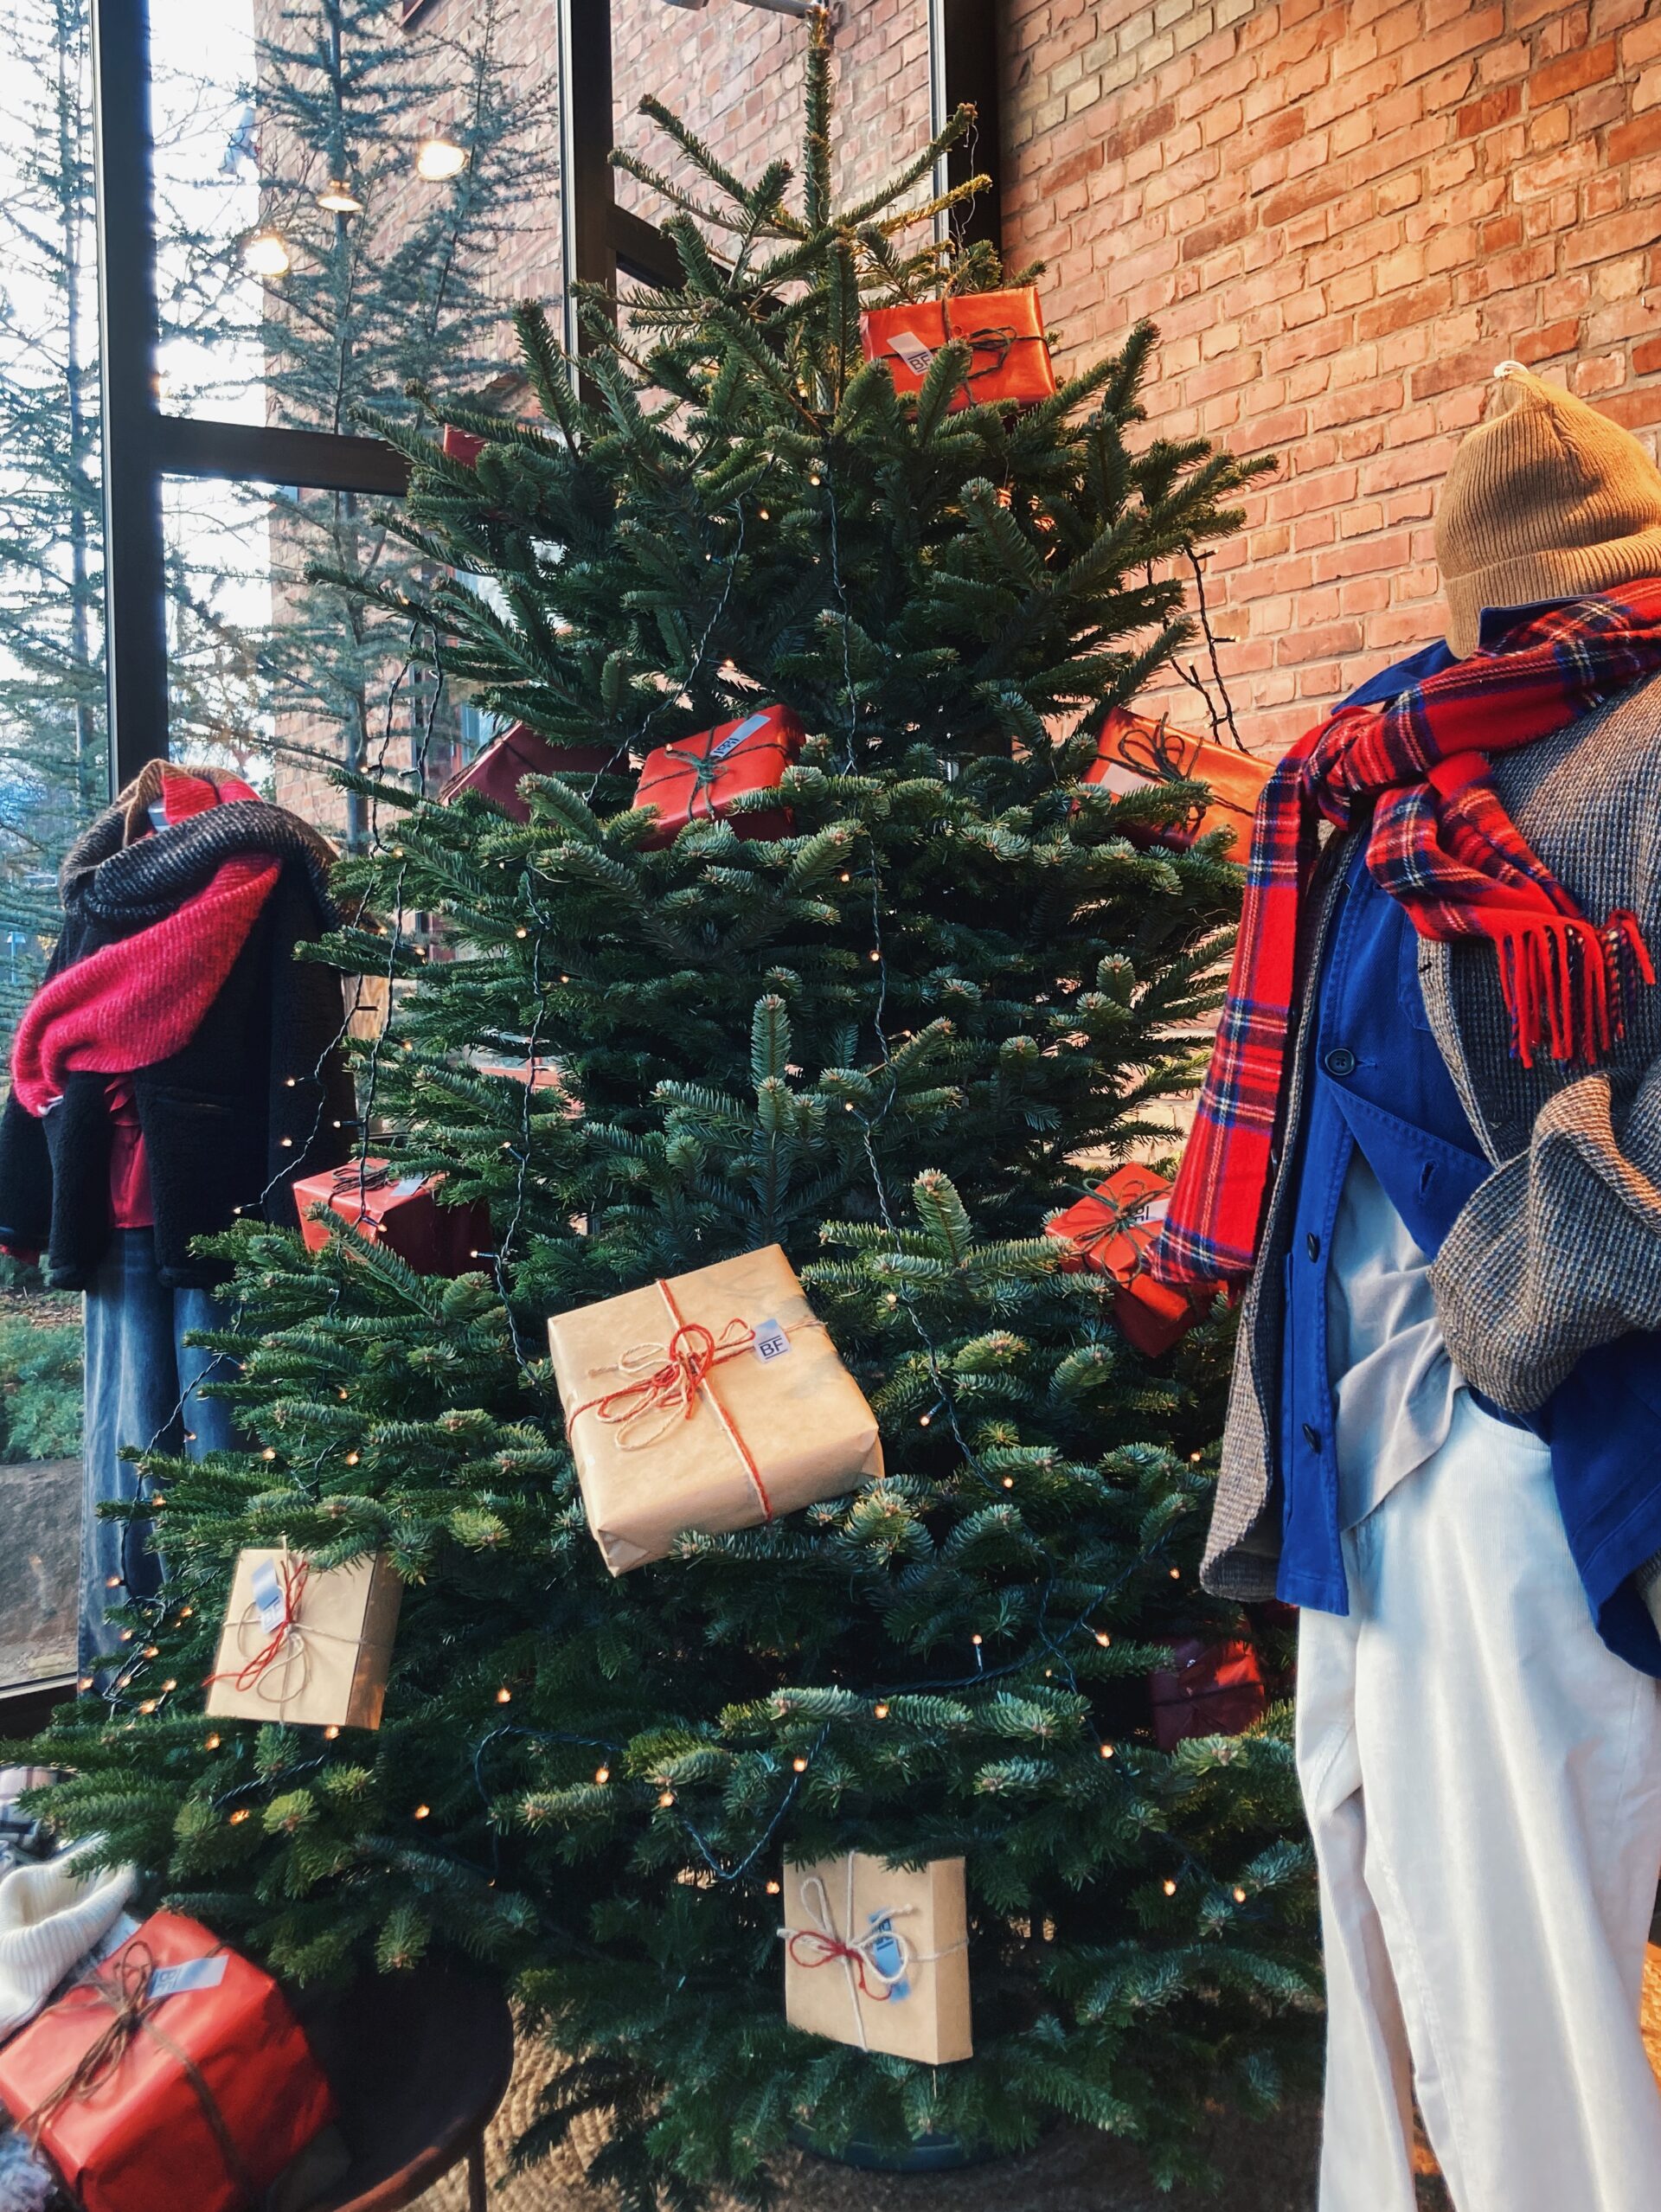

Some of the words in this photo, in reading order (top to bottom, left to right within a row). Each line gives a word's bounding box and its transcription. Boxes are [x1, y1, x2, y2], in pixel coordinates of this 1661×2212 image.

[909, 355, 932, 370] BF
[760, 1337, 784, 1356] BF
[264, 1600, 282, 1625] BF
[158, 1970, 177, 1991] BF
